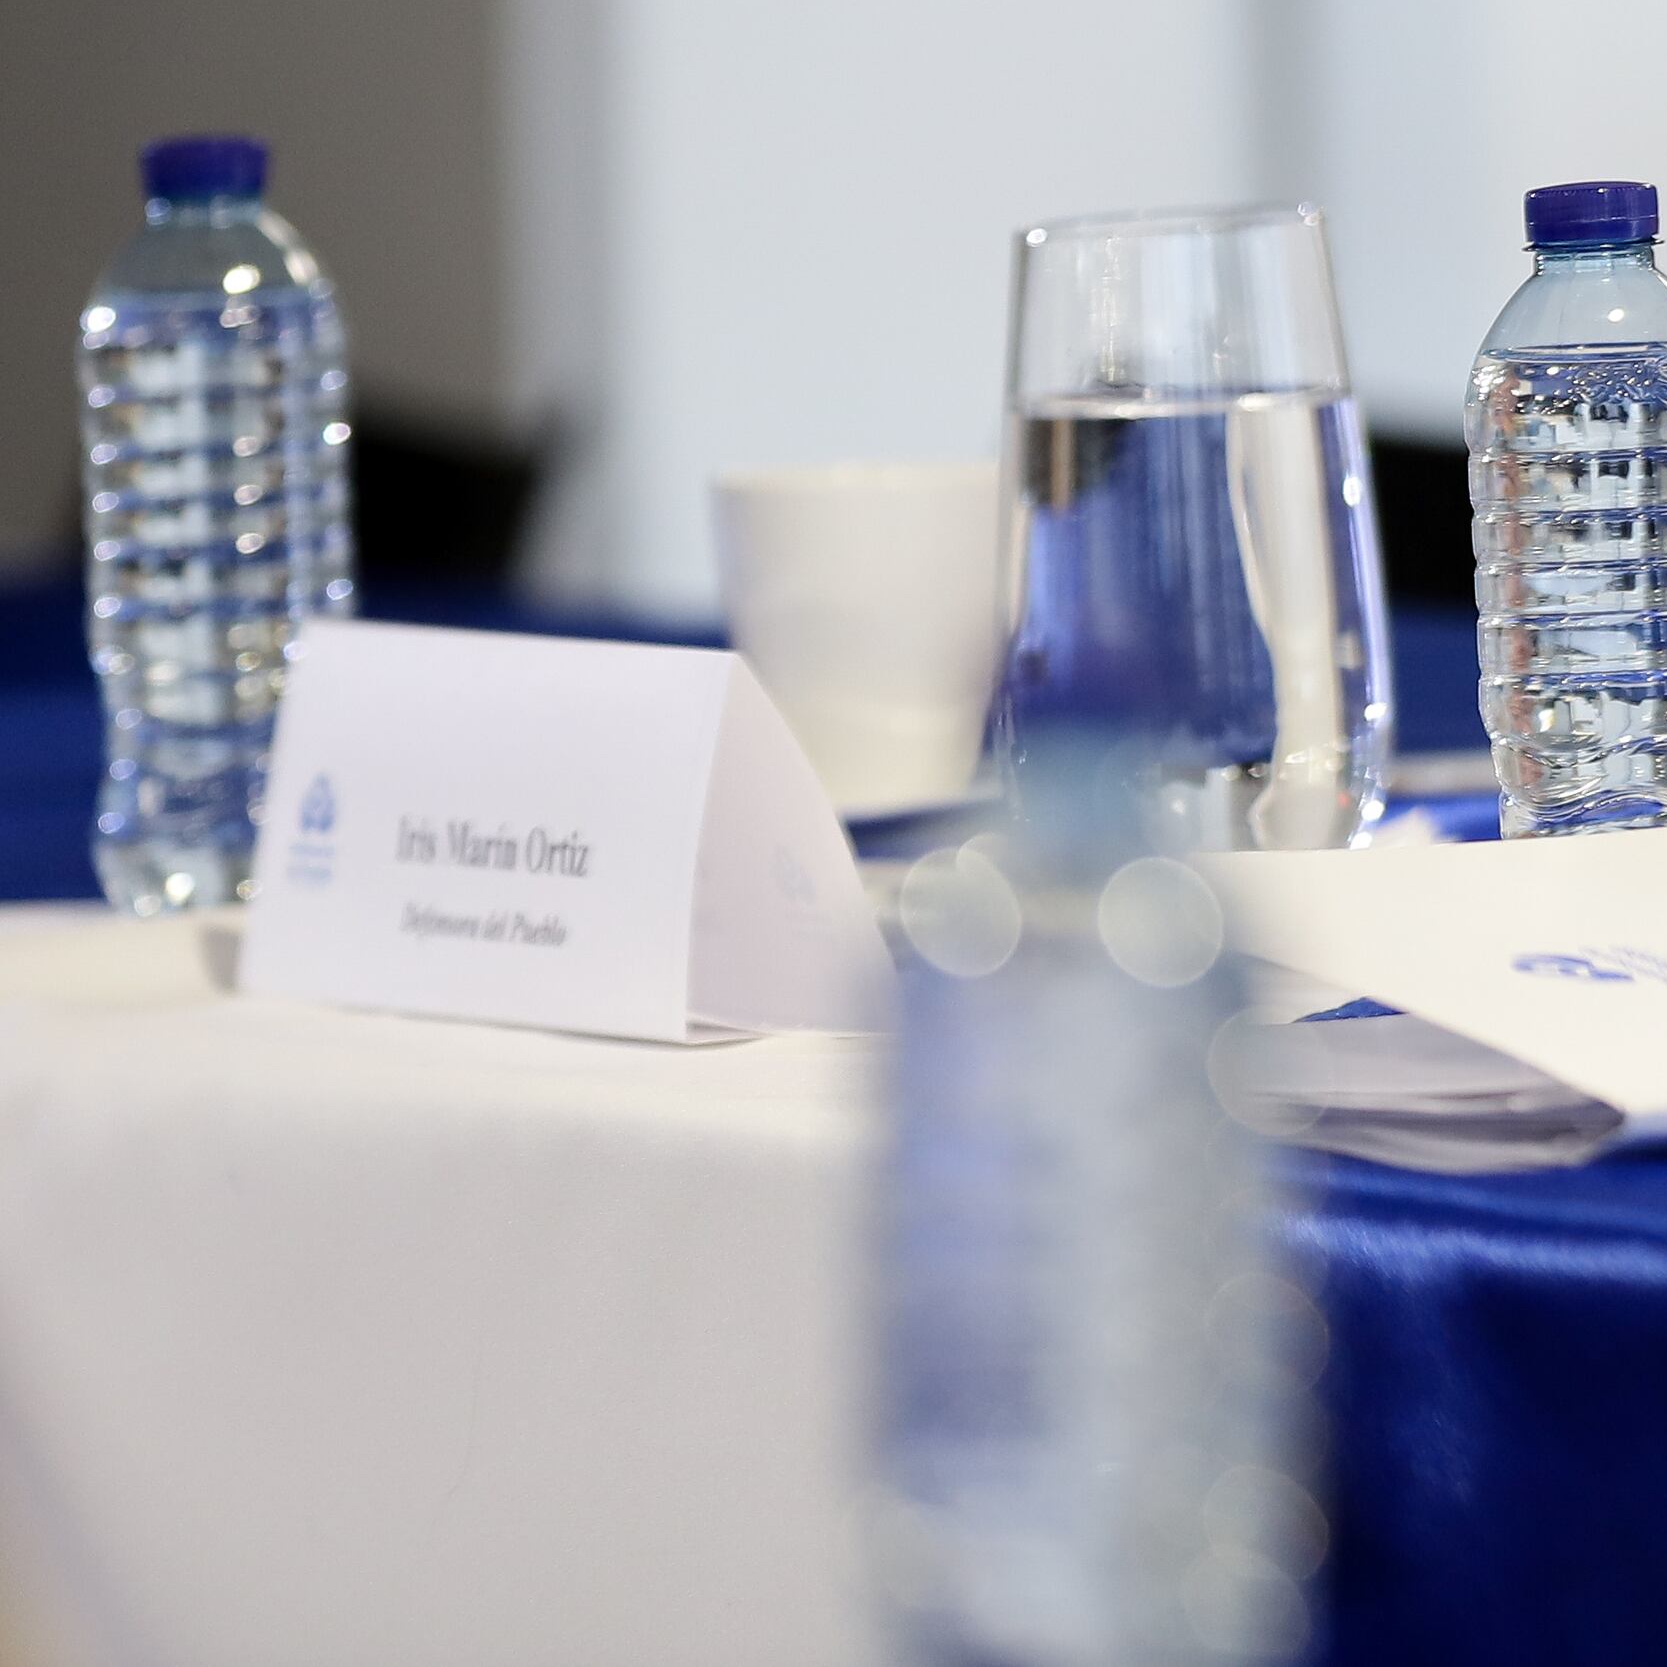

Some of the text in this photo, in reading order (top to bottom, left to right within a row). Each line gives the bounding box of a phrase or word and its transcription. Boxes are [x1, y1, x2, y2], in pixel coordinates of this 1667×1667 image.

[396, 814, 590, 877] Iris Marín Ortiz
[509, 911, 567, 946] Pueblo
